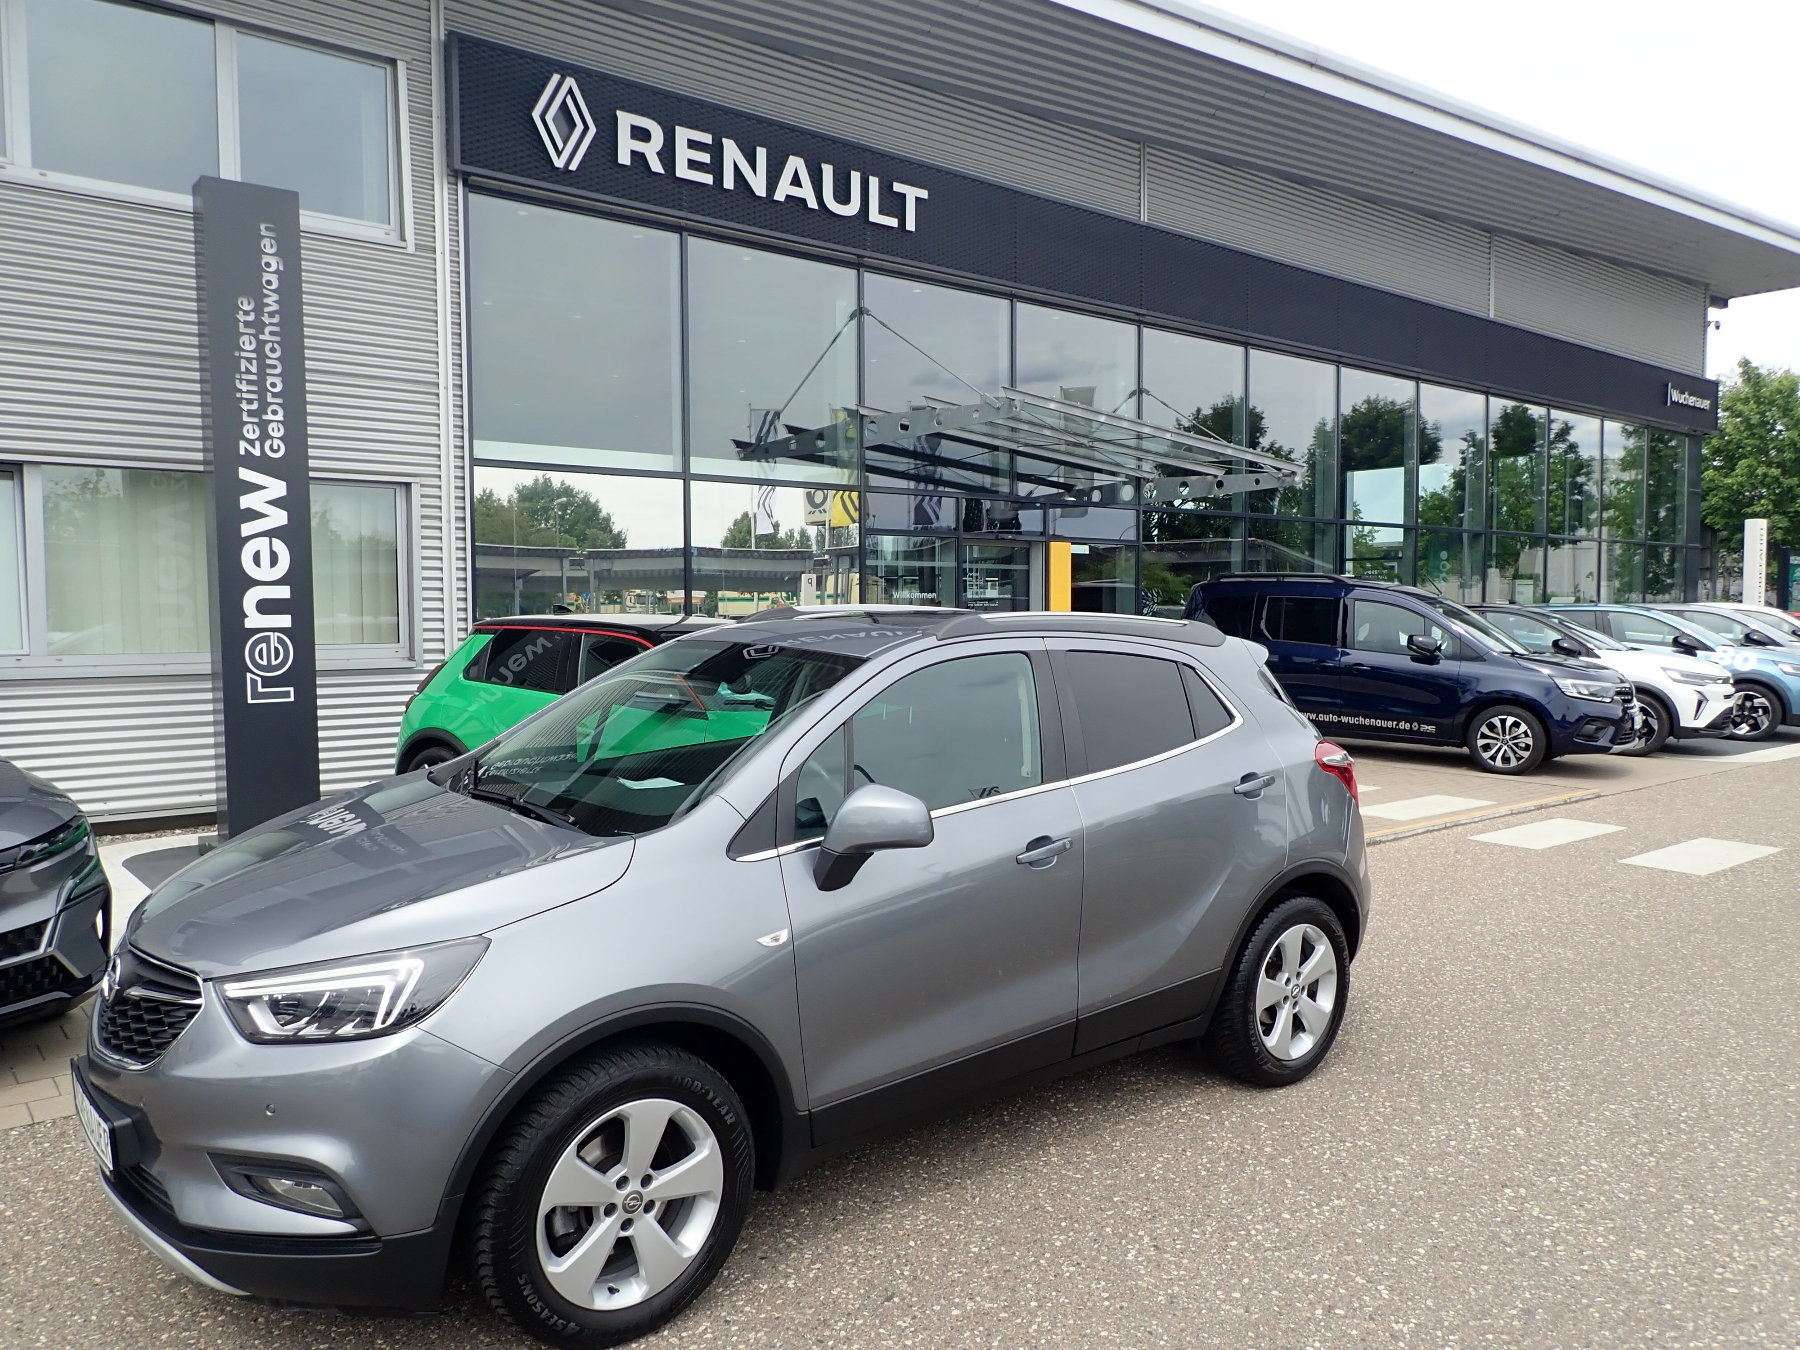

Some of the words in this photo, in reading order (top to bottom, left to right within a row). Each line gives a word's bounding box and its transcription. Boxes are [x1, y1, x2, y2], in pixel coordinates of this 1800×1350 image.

[616, 110, 929, 232] RENAULT
[234, 294, 261, 457] Zertifizierte
[258, 223, 287, 459] Gebrauchtwagen
[1671, 389, 1710, 410] Wuchenauer
[238, 467, 295, 704] renew
[893, 590, 937, 599] Willkommen
[1301, 711, 1411, 730] ww.auto-wuchenauer.de
